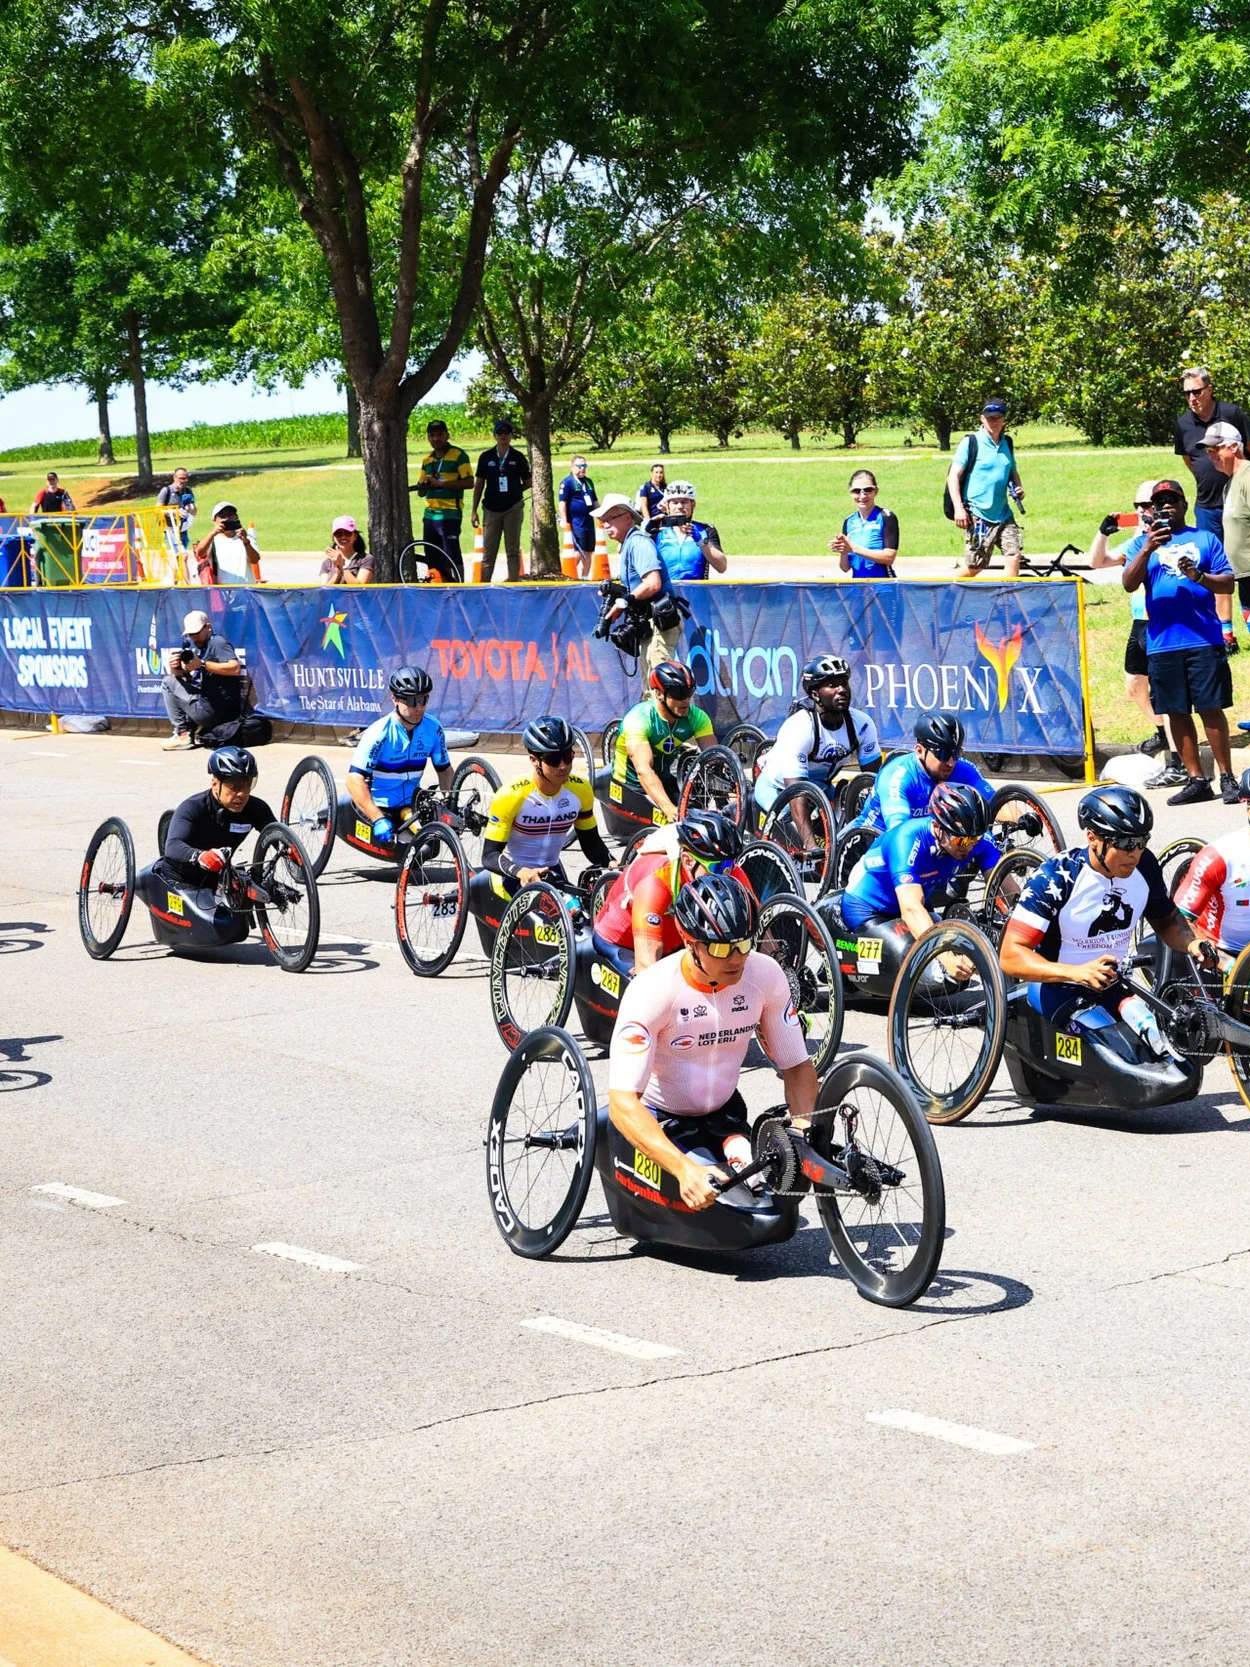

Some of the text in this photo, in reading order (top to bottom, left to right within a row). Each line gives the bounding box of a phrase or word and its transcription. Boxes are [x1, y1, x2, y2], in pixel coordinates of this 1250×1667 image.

[4, 617, 92, 650] LOCAL EVENT
[17, 655, 88, 688] SPONSORS
[293, 663, 385, 690] HUNTSVILLE
[431, 638, 600, 682] TOYOTA AL
[676, 629, 799, 698] dtran
[299, 695, 316, 711] The
[316, 696, 337, 711] Star
[346, 695, 382, 713] Alabama
[522, 811, 578, 824] THAILAND
[1180, 855, 1215, 909] PORTUGAL
[433, 902, 456, 917] 283
[859, 940, 880, 959] 277
[601, 969, 618, 993] 287
[1057, 1037, 1079, 1061] 284
[561, 1050, 587, 1168] CADEX
[489, 1117, 515, 1234] CADEX
[636, 1152, 660, 1185] 280
